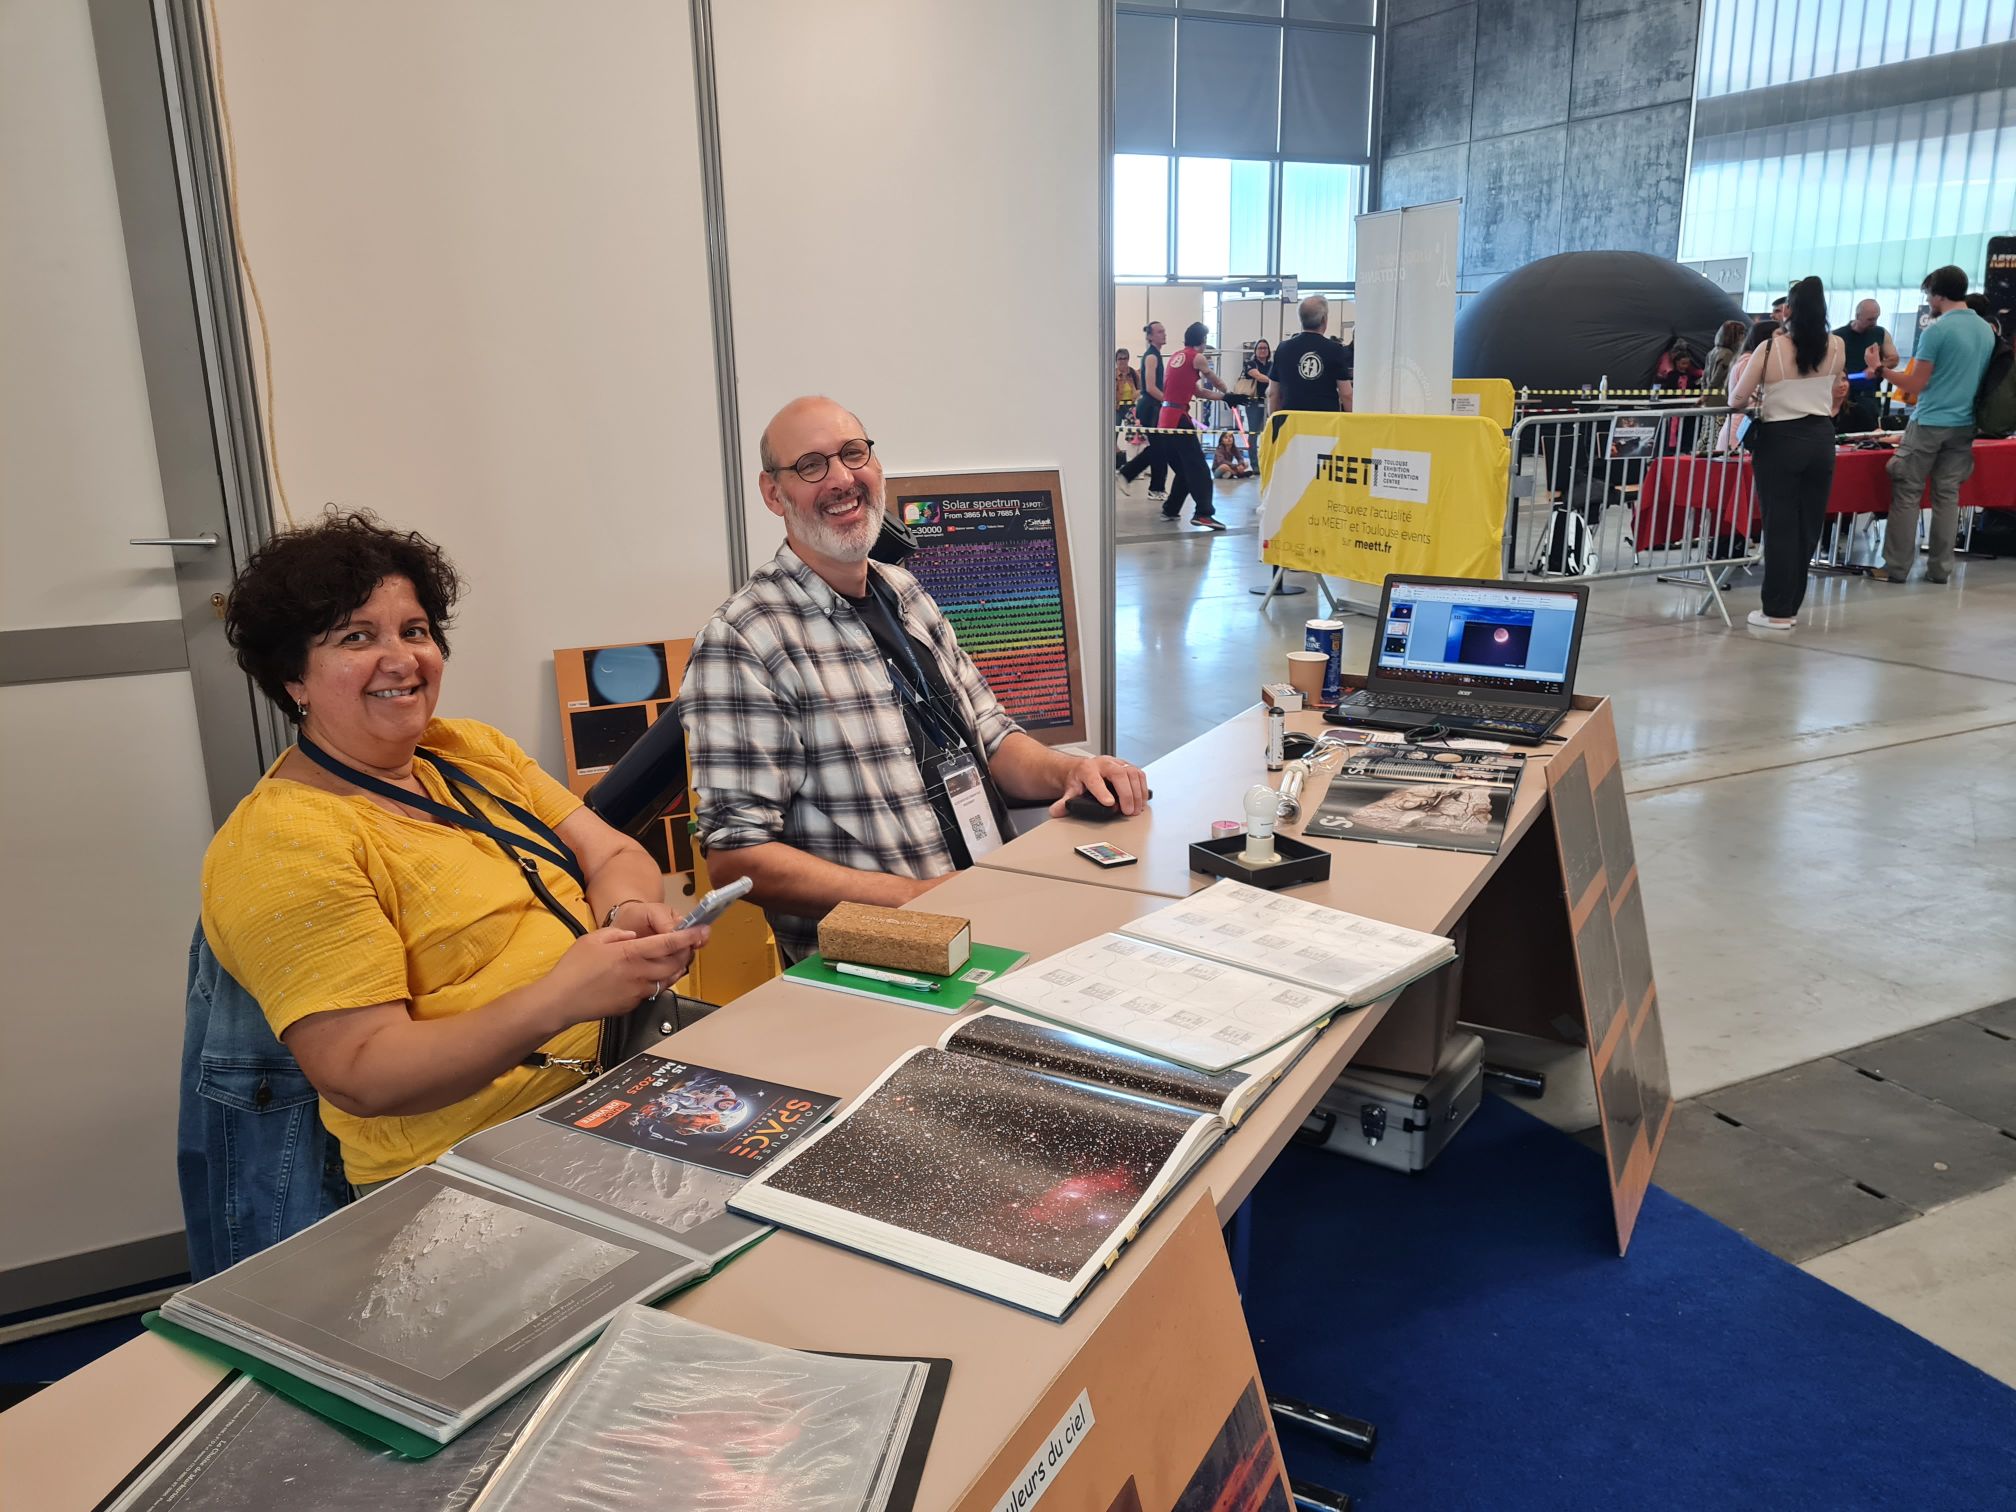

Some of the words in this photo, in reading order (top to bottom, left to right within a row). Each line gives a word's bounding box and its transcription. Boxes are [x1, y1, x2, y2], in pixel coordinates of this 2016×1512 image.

[1384, 459, 1408, 467] TOULOUSE
[1387, 473, 1419, 481] CONVENTION
[942, 500, 973, 510] Solar
[974, 498, 1020, 509] spectrum
[1328, 500, 1368, 517] Retrouvez
[1369, 505, 1412, 523] l'actualité
[1308, 515, 1320, 526] du
[1349, 521, 1360, 532] et
[1361, 522, 1399, 539] Toulouse
[1401, 530, 1431, 544] events
[1354, 538, 1392, 553] meett.fr
[1457, 689, 1473, 697] acer
[652, 1061, 677, 1077] MAI
[626, 1076, 656, 1095] 2025
[607, 1101, 620, 1110] DE
[728, 1099, 812, 1159] SPACE
[753, 1105, 822, 1161] TOULOUSE
[1048, 1439, 1064, 1467] du
[1065, 1403, 1086, 1444] ciel
